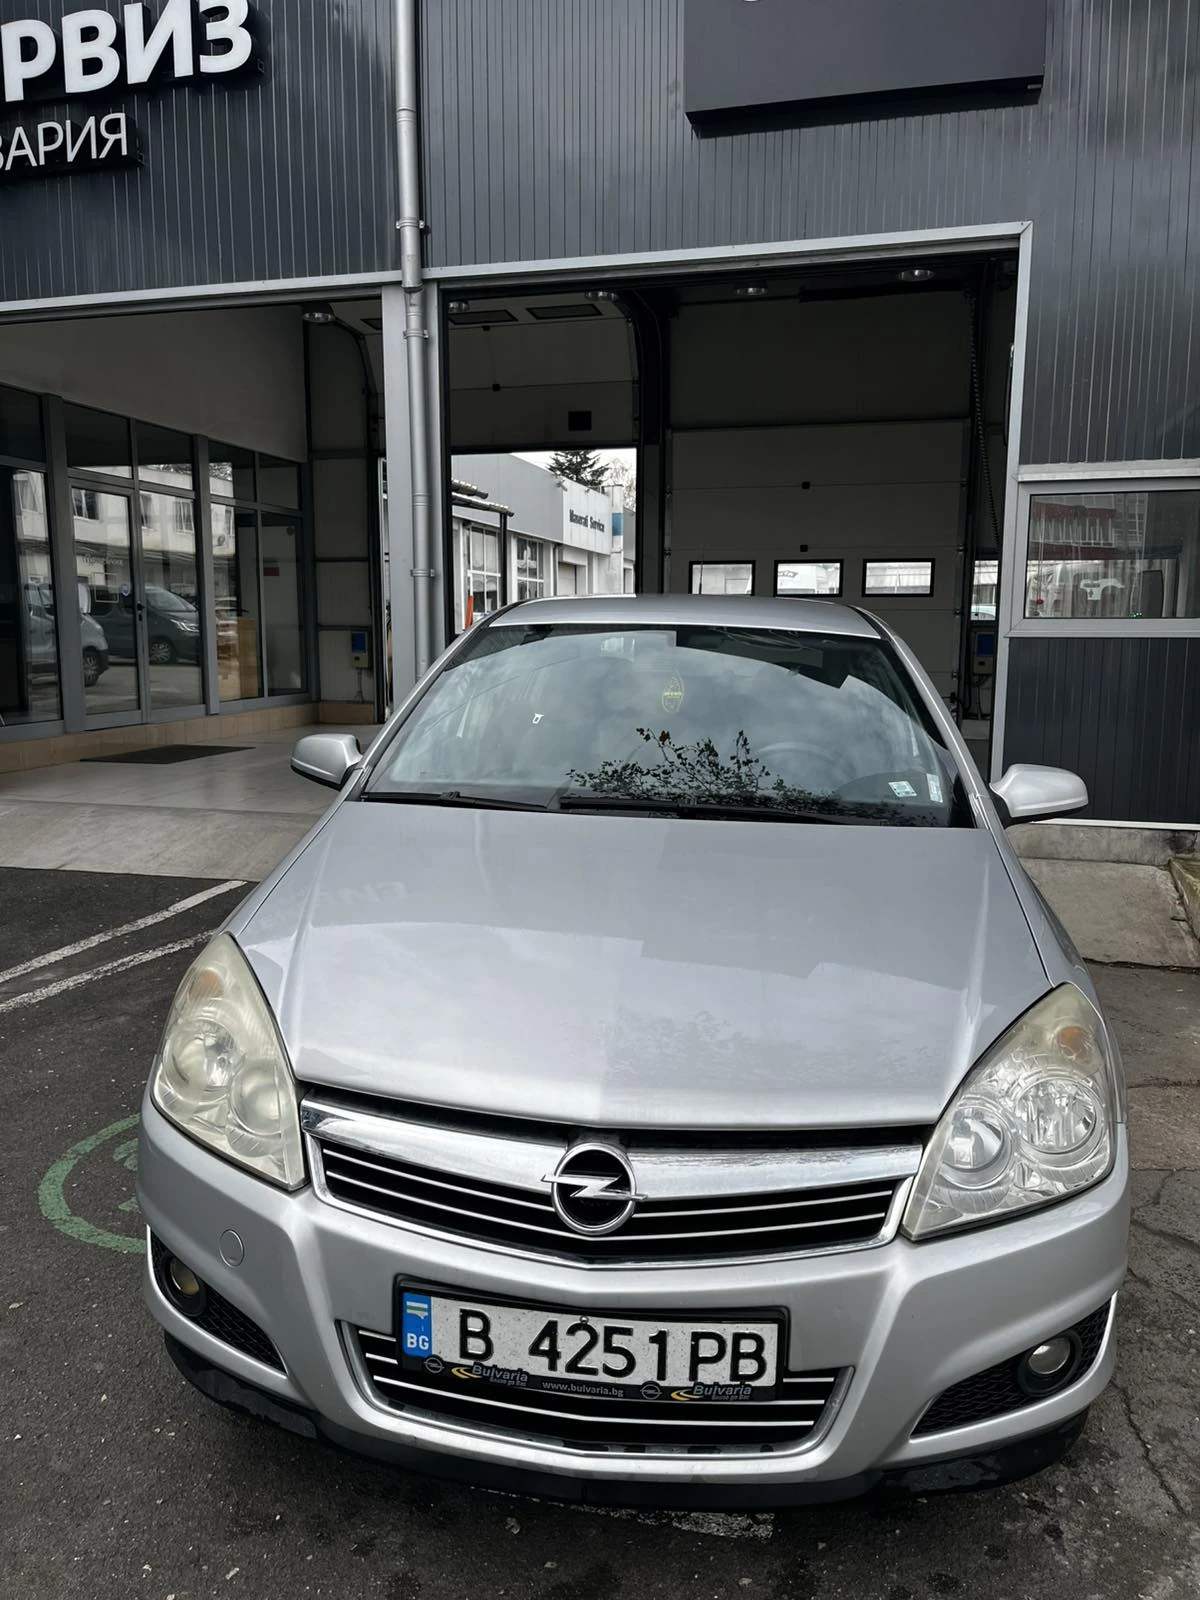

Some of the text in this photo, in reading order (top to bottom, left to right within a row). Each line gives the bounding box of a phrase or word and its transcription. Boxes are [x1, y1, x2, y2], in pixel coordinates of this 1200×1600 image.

[0, 112, 128, 172] АРИЯ
[406, 1332, 430, 1351] BG
[459, 1308, 495, 1361] B
[528, 1319, 670, 1382] 4251
[472, 1365, 528, 1382] Bulvaria
[542, 1381, 624, 1397] www.bulvaria.bg
[693, 1385, 752, 1396] Bulvaria
